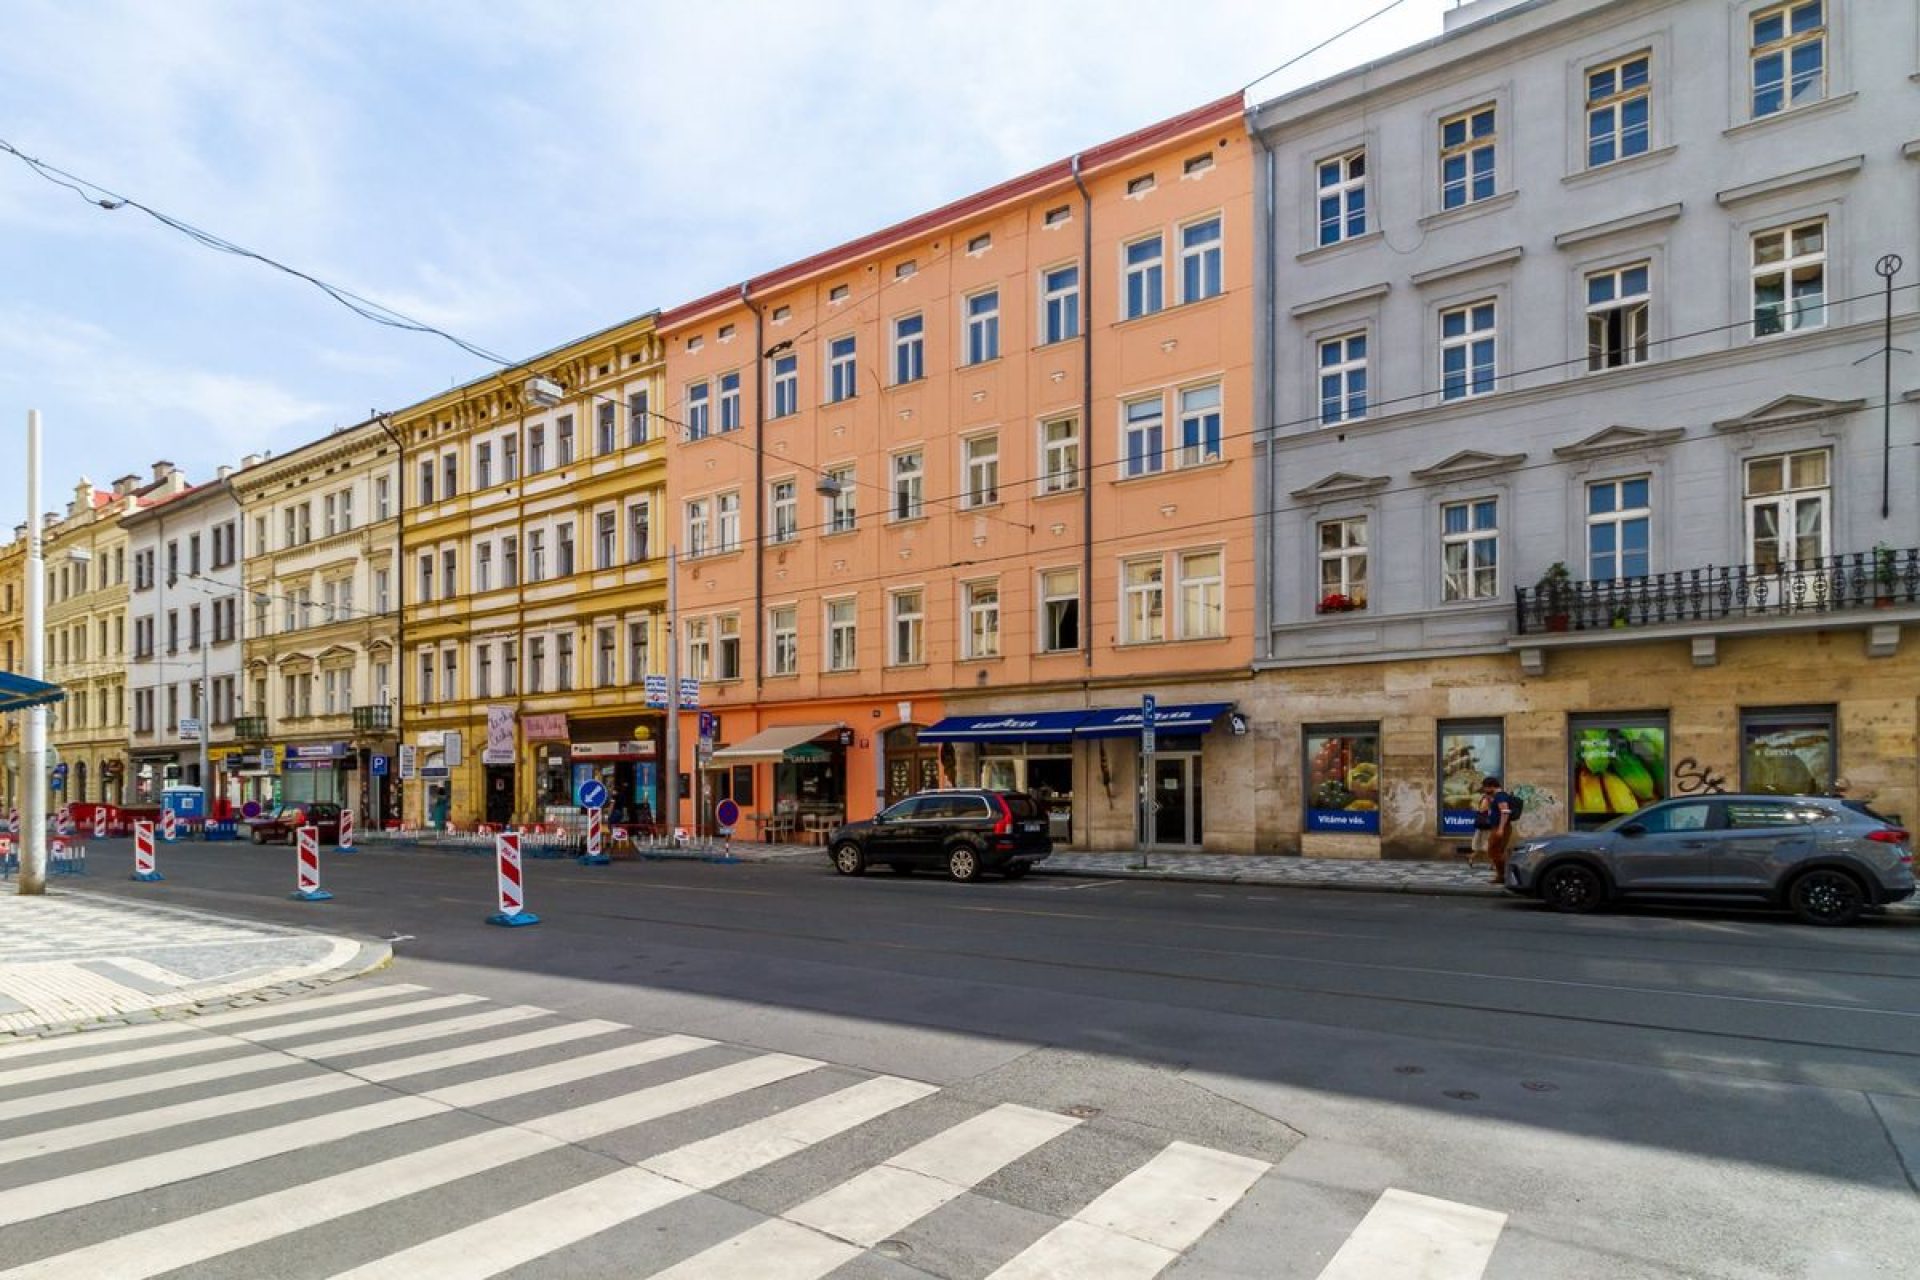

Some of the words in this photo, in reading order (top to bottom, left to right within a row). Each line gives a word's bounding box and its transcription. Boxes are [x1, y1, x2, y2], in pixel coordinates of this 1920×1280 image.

[374, 757, 384, 769] P
[1318, 815, 1348, 824] Vitáme
[1348, 815, 1366, 825] vás.
